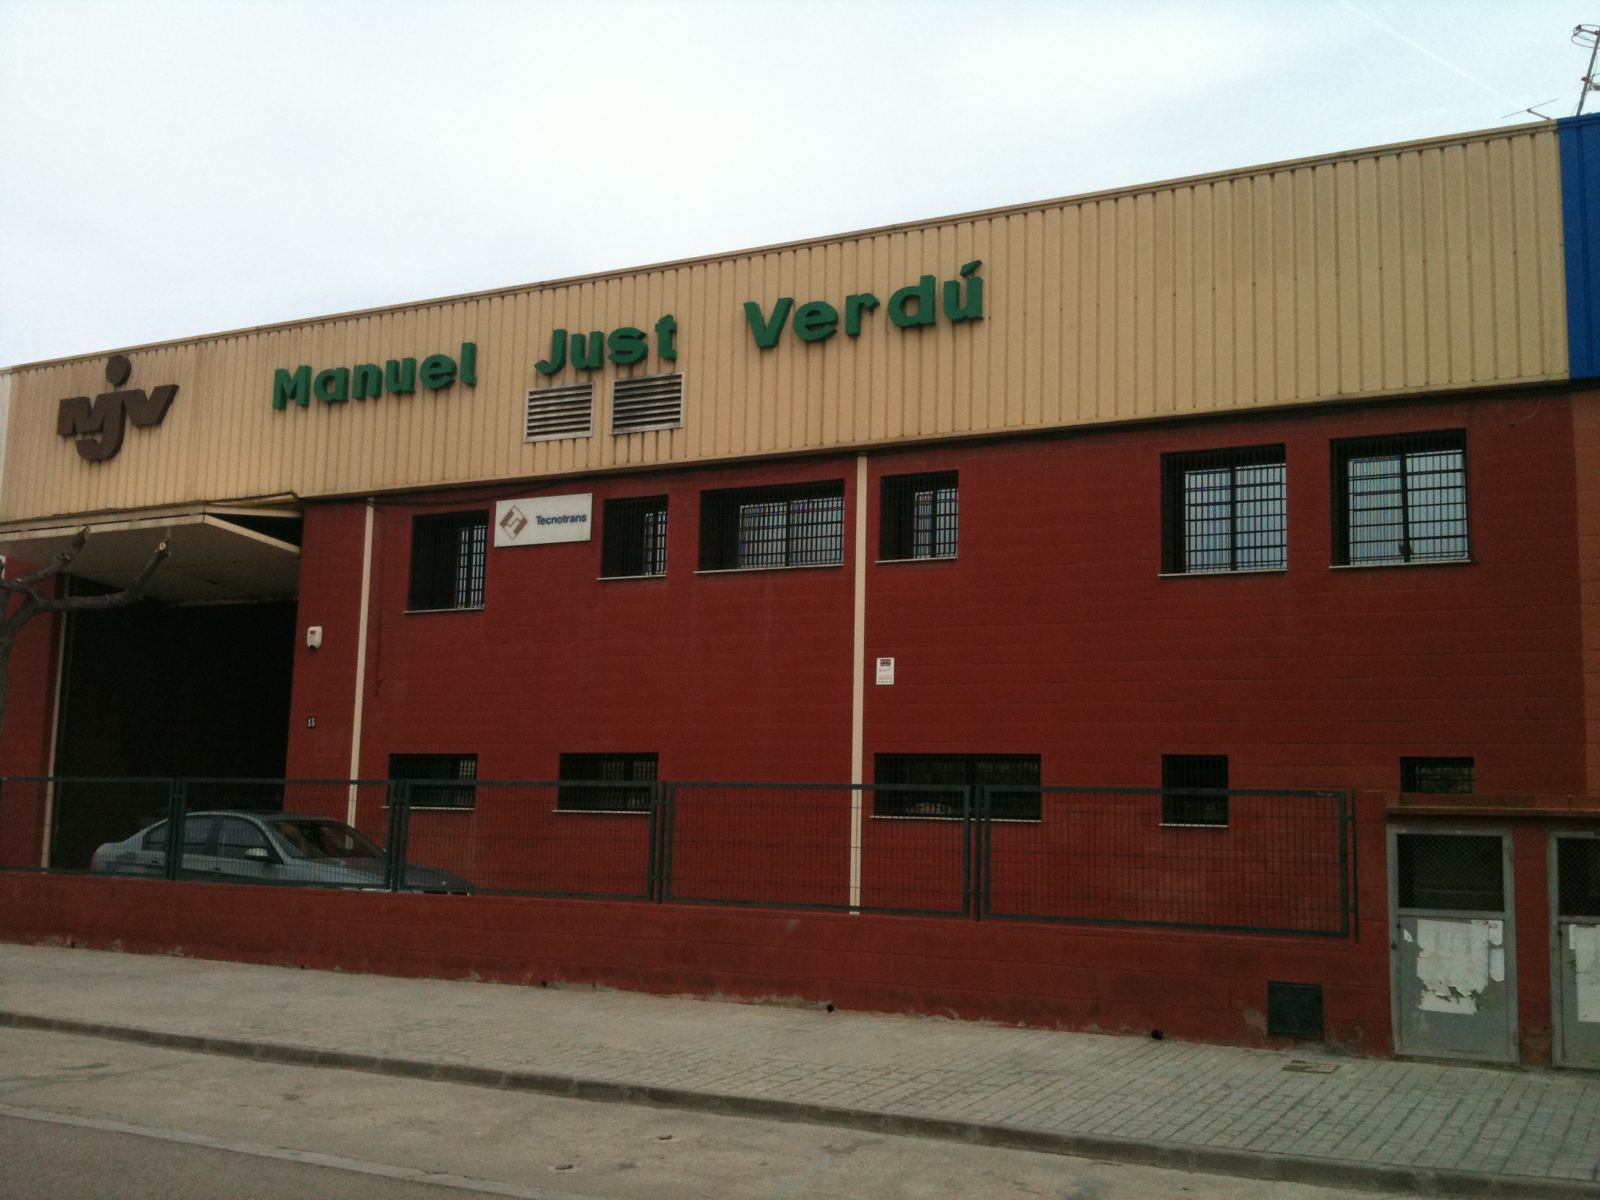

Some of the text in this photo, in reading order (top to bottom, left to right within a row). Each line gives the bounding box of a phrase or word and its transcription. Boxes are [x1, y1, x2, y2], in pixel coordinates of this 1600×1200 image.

[272, 259, 984, 411] Manuel Just Verdú
[535, 513, 588, 526] Tecnotrans
